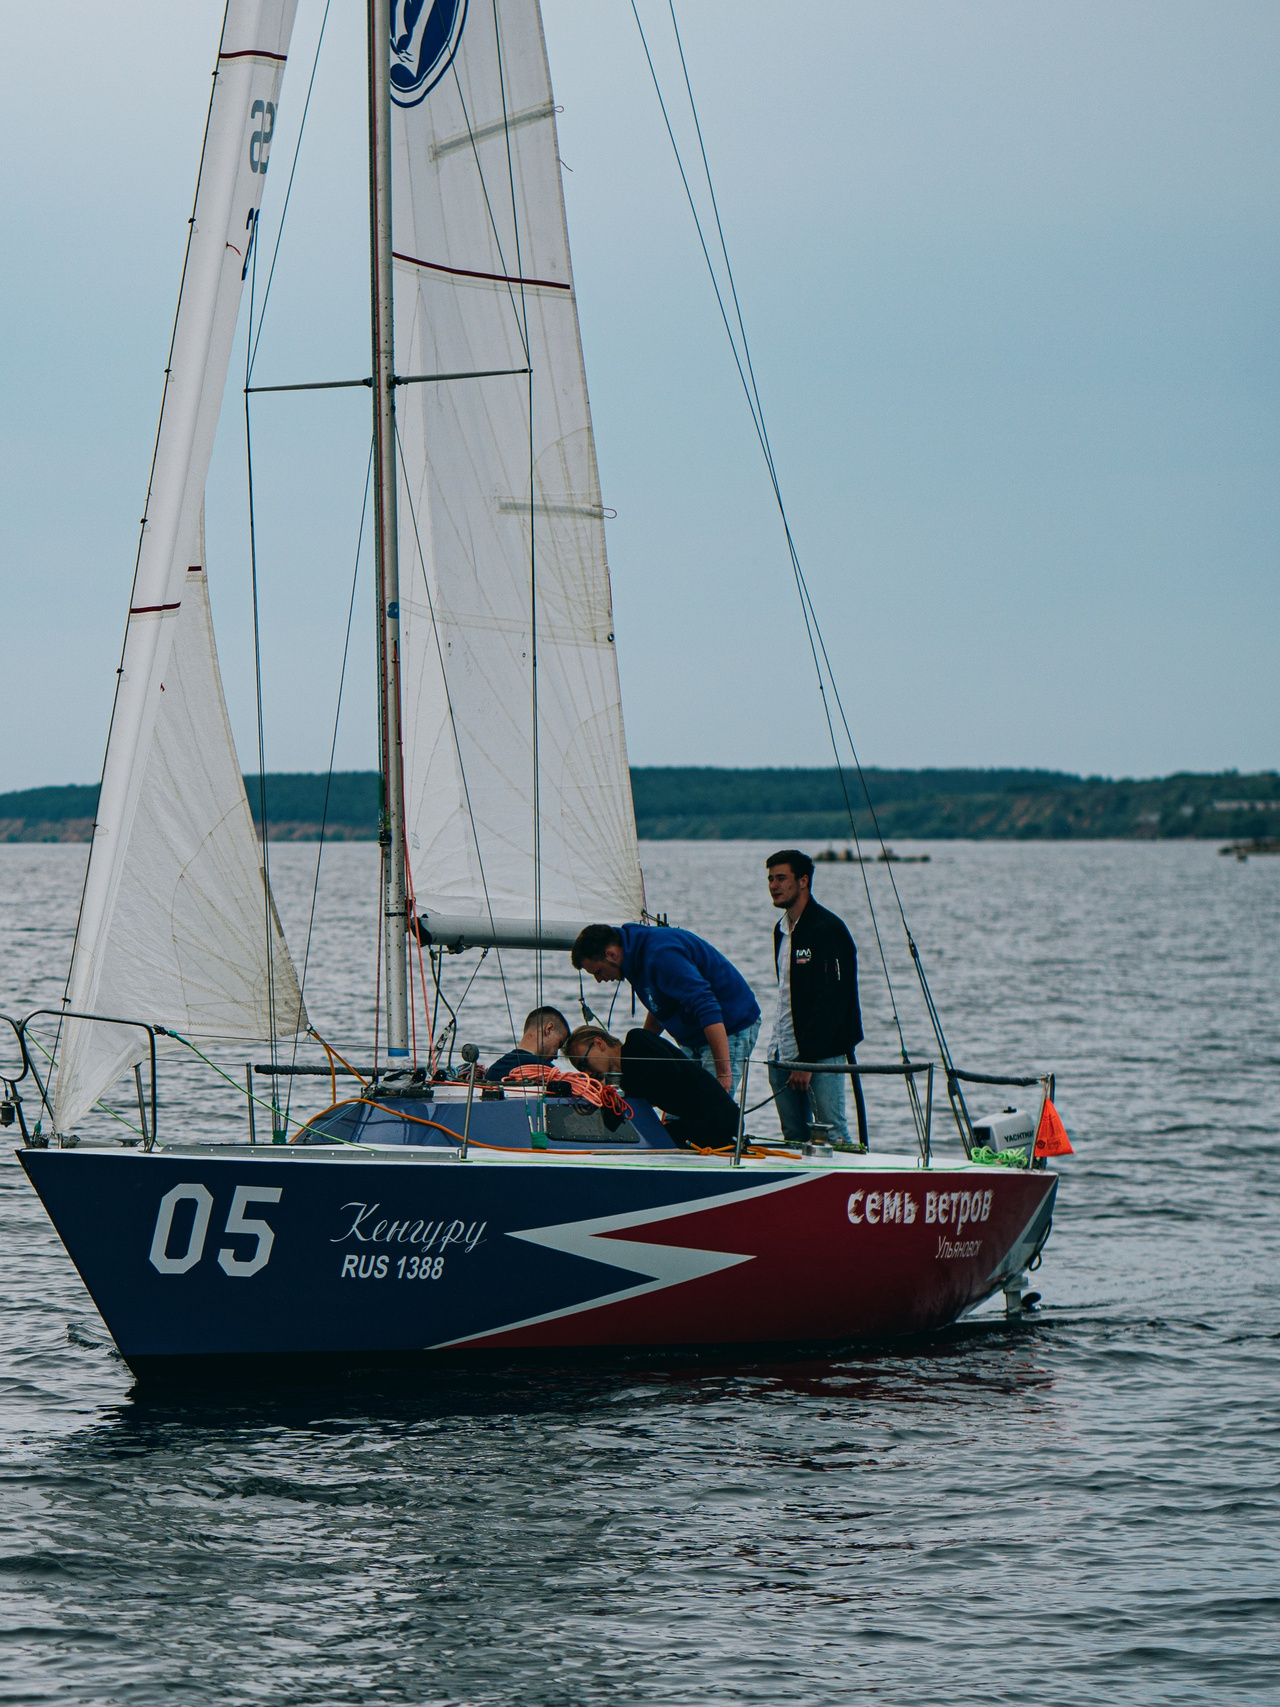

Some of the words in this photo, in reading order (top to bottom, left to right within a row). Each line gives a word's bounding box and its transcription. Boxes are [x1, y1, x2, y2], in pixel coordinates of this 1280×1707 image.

[149, 1183, 283, 1277] 05
[330, 1202, 487, 1253] Кенгуру
[341, 1254, 389, 1279] RUS
[396, 1255, 445, 1280] 1388
